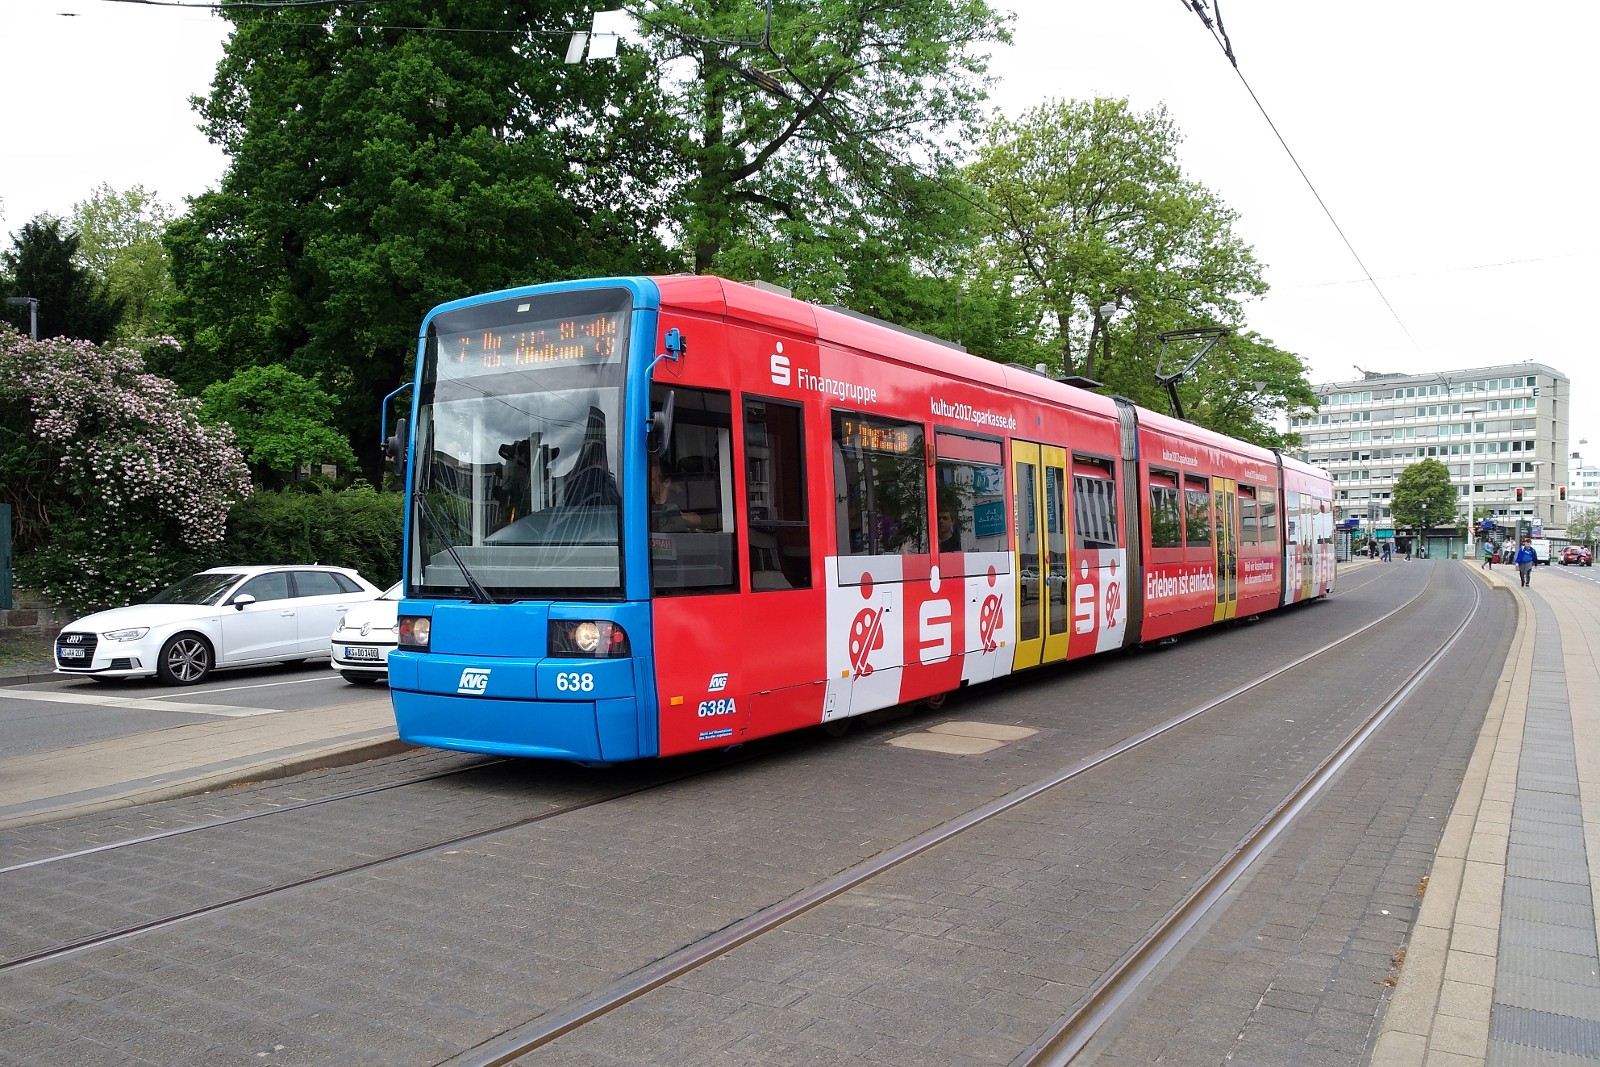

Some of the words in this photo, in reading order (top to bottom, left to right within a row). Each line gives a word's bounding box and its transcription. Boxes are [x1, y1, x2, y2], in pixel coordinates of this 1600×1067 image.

[797, 367, 877, 405] Finanzgruppe
[930, 396, 1017, 431] kultur2017.sparkasse.de
[1147, 570, 1178, 599] Erleben
[1179, 569, 1189, 594] ist
[1190, 566, 1215, 592] einfach.
[457, 670, 490, 691] KVG
[556, 672, 595, 692] 638
[709, 675, 728, 690] KVG
[697, 697, 737, 718] 638A
